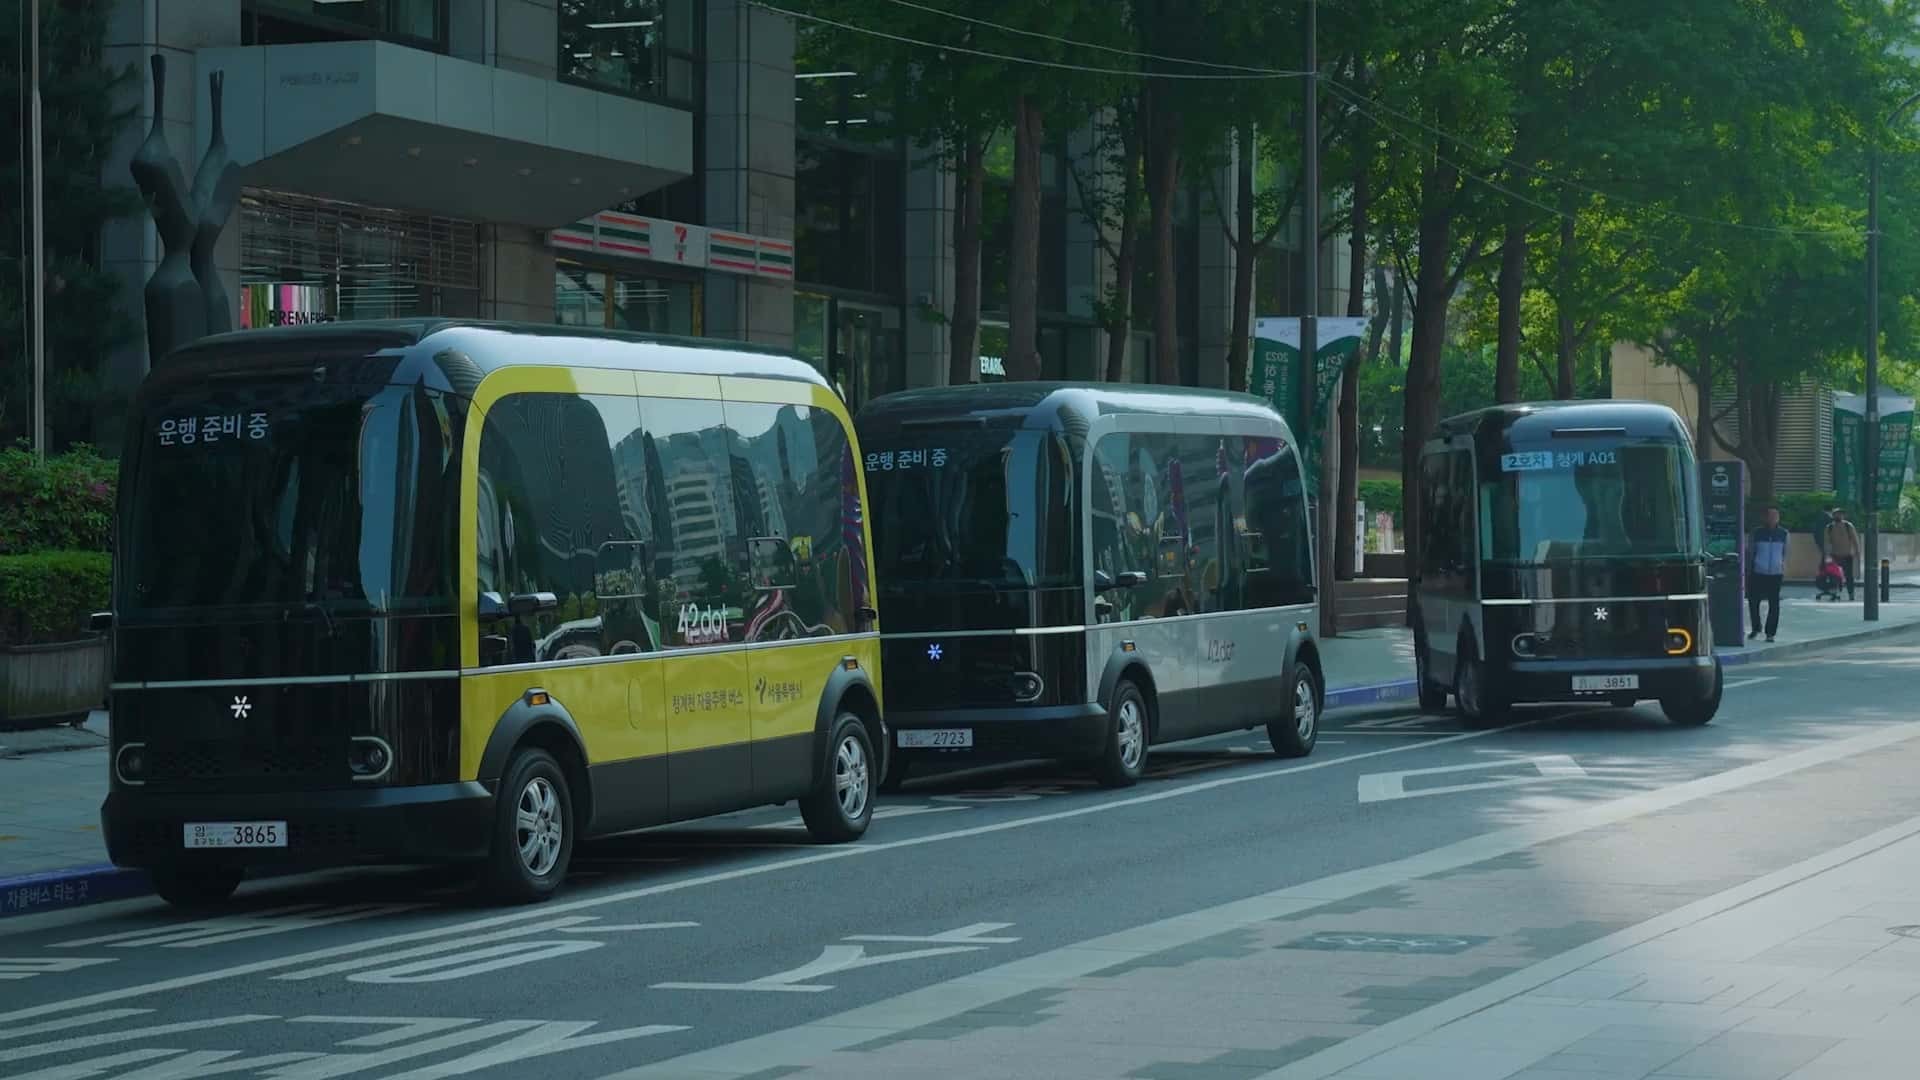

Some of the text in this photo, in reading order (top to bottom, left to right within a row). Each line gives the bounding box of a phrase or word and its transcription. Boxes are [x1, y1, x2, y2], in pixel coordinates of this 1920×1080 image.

[159, 411, 270, 446] 운행 준비 중
[864, 448, 948, 472] 운행 준비 중
[1589, 451, 1617, 465] A01
[677, 602, 729, 639] 42dot
[1206, 640, 1236, 663] 42dot
[1603, 677, 1632, 690] 3851
[672, 688, 744, 715] 청계천 자율주행 버스
[931, 731, 965, 745] 2723
[233, 825, 276, 845] 3865
